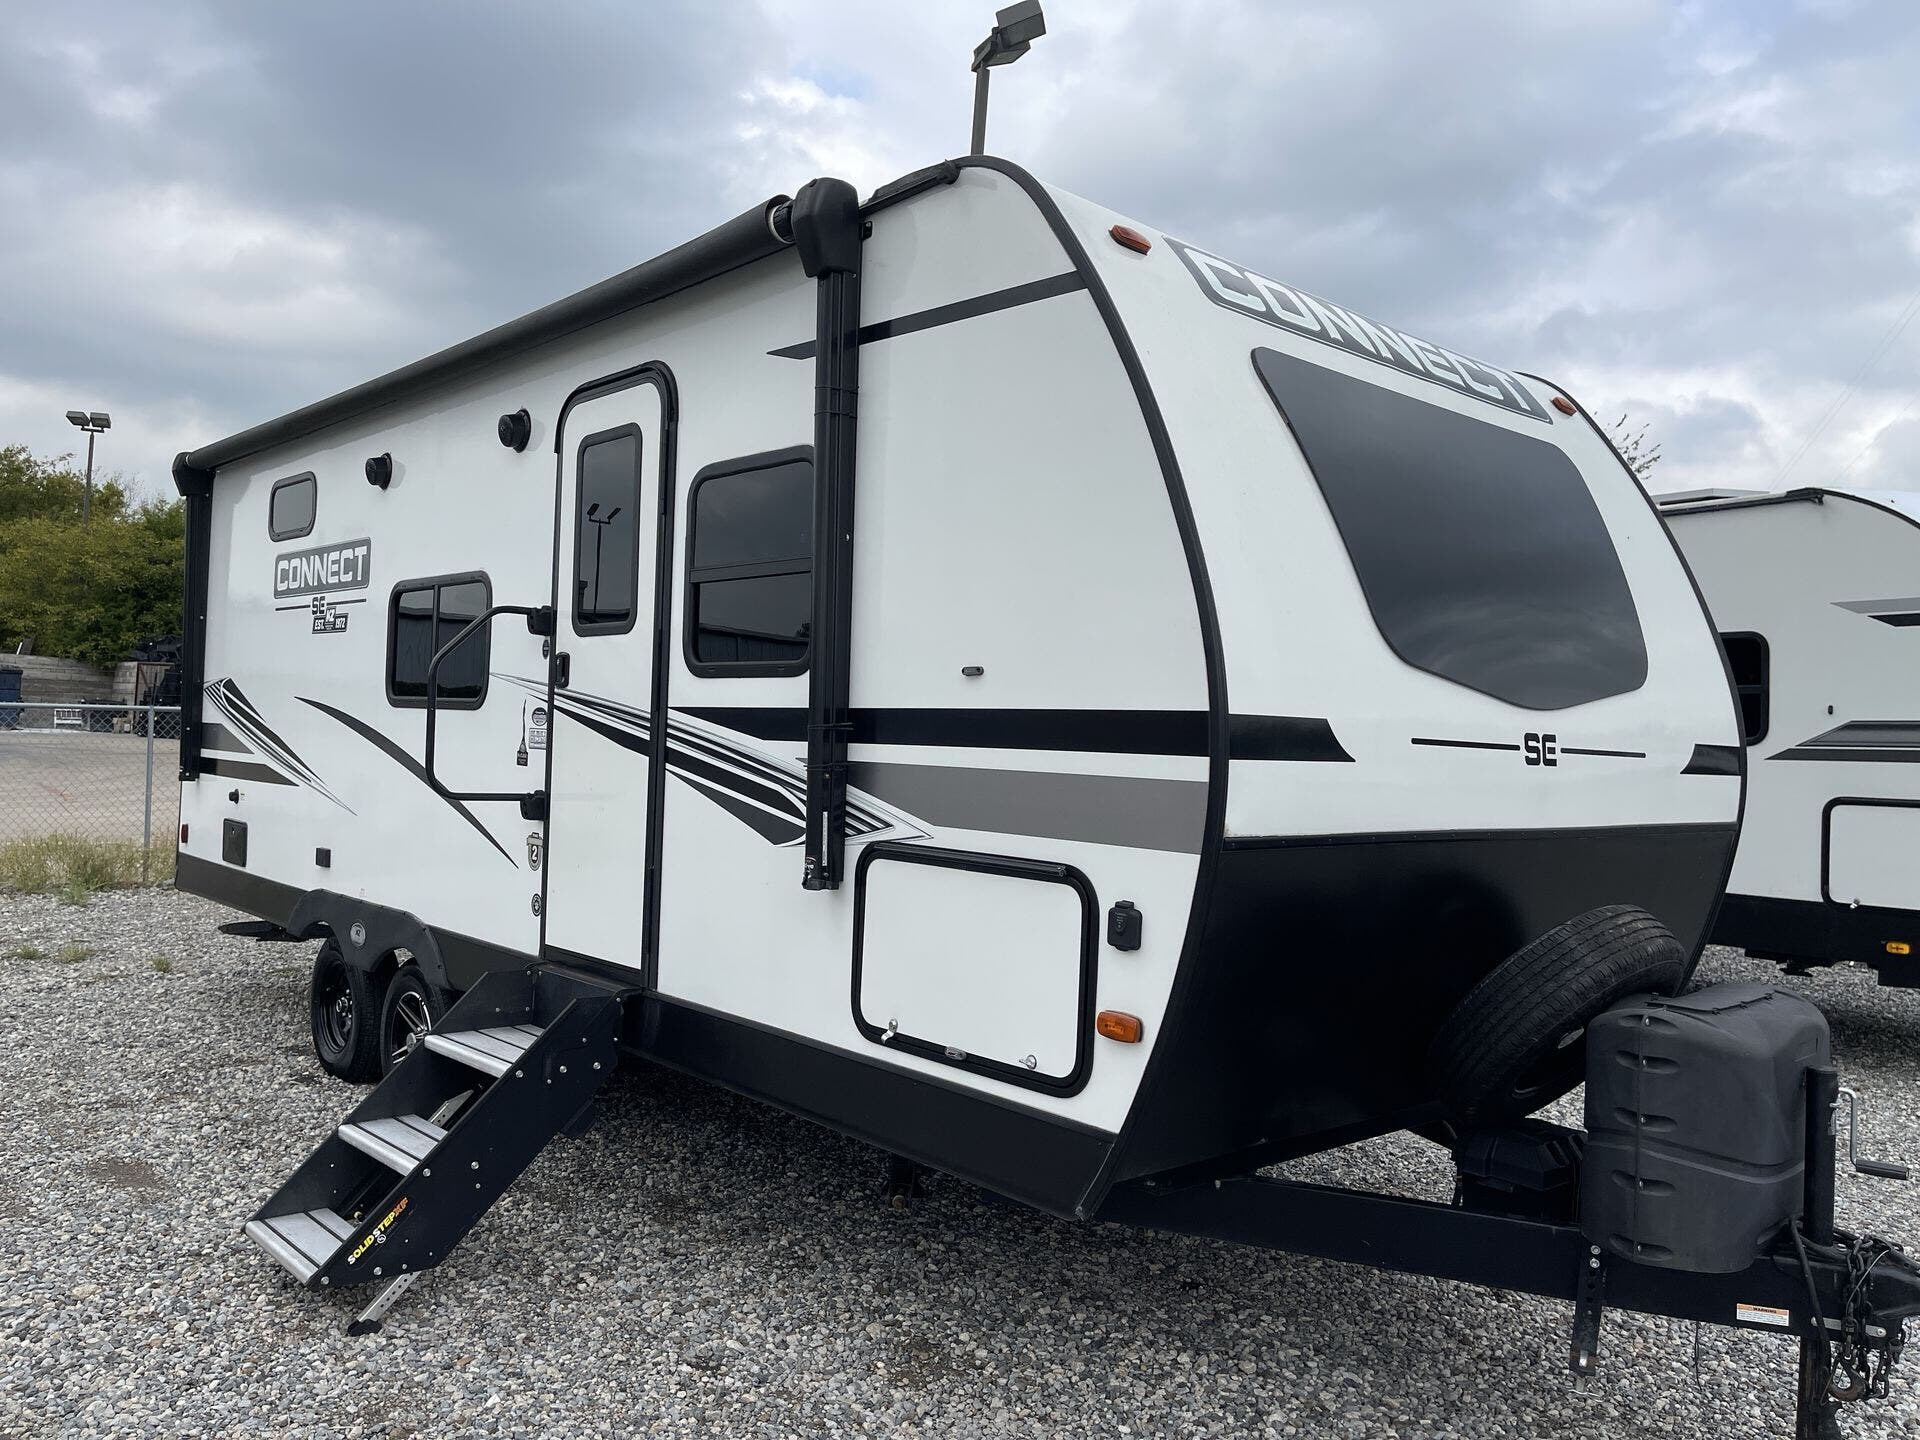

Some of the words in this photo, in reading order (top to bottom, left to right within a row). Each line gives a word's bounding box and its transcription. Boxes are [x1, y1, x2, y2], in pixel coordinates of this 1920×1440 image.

[1183, 247, 1532, 412] CONNECT
[276, 545, 368, 591] CONNECT
[311, 595, 326, 616] SE
[1523, 732, 1558, 767] SE
